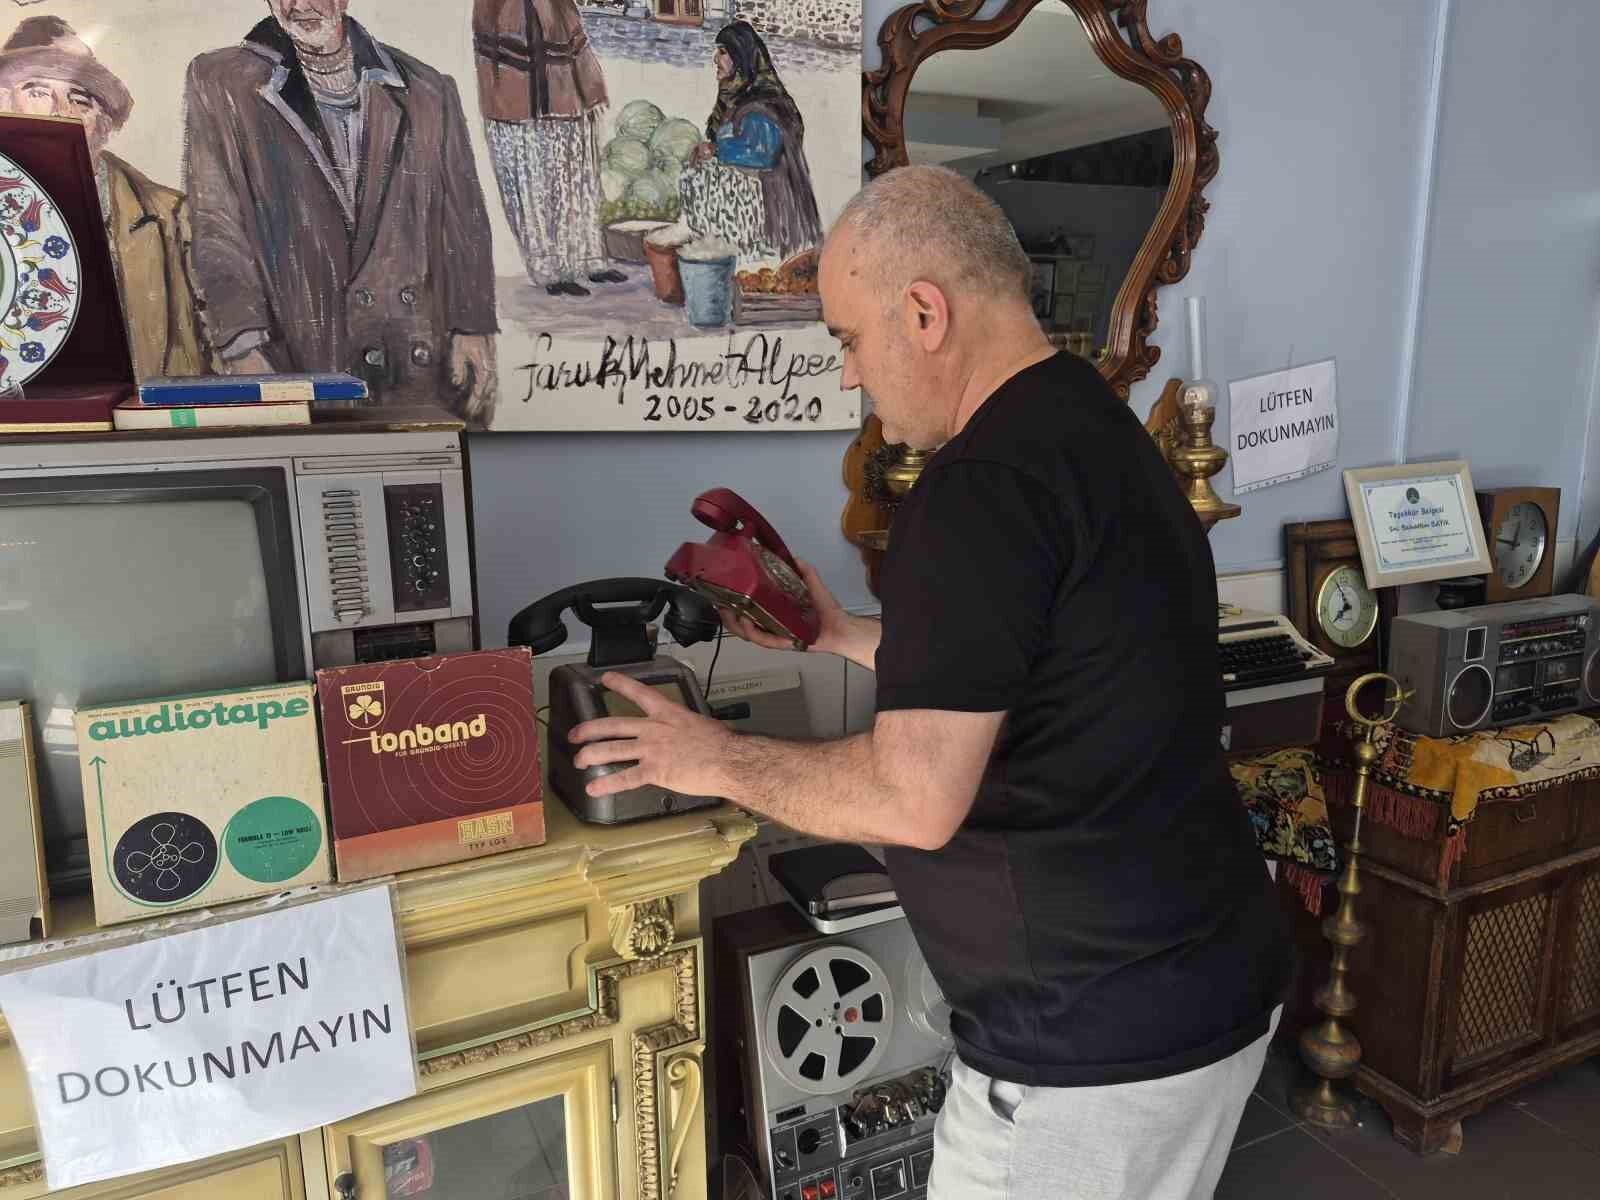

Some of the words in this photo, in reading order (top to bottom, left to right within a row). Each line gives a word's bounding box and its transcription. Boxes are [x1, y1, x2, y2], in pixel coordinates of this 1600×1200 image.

[1260, 386, 1313, 413] LÜTFEN
[1237, 414, 1335, 451] DOKUNMAYIN
[345, 683, 382, 693] GRUNDIG
[88, 697, 310, 742] audiotape
[370, 713, 487, 755] tonband
[125, 955, 309, 1031] LÜTFEN
[57, 1003, 393, 1105] DOKUNMAYIN
